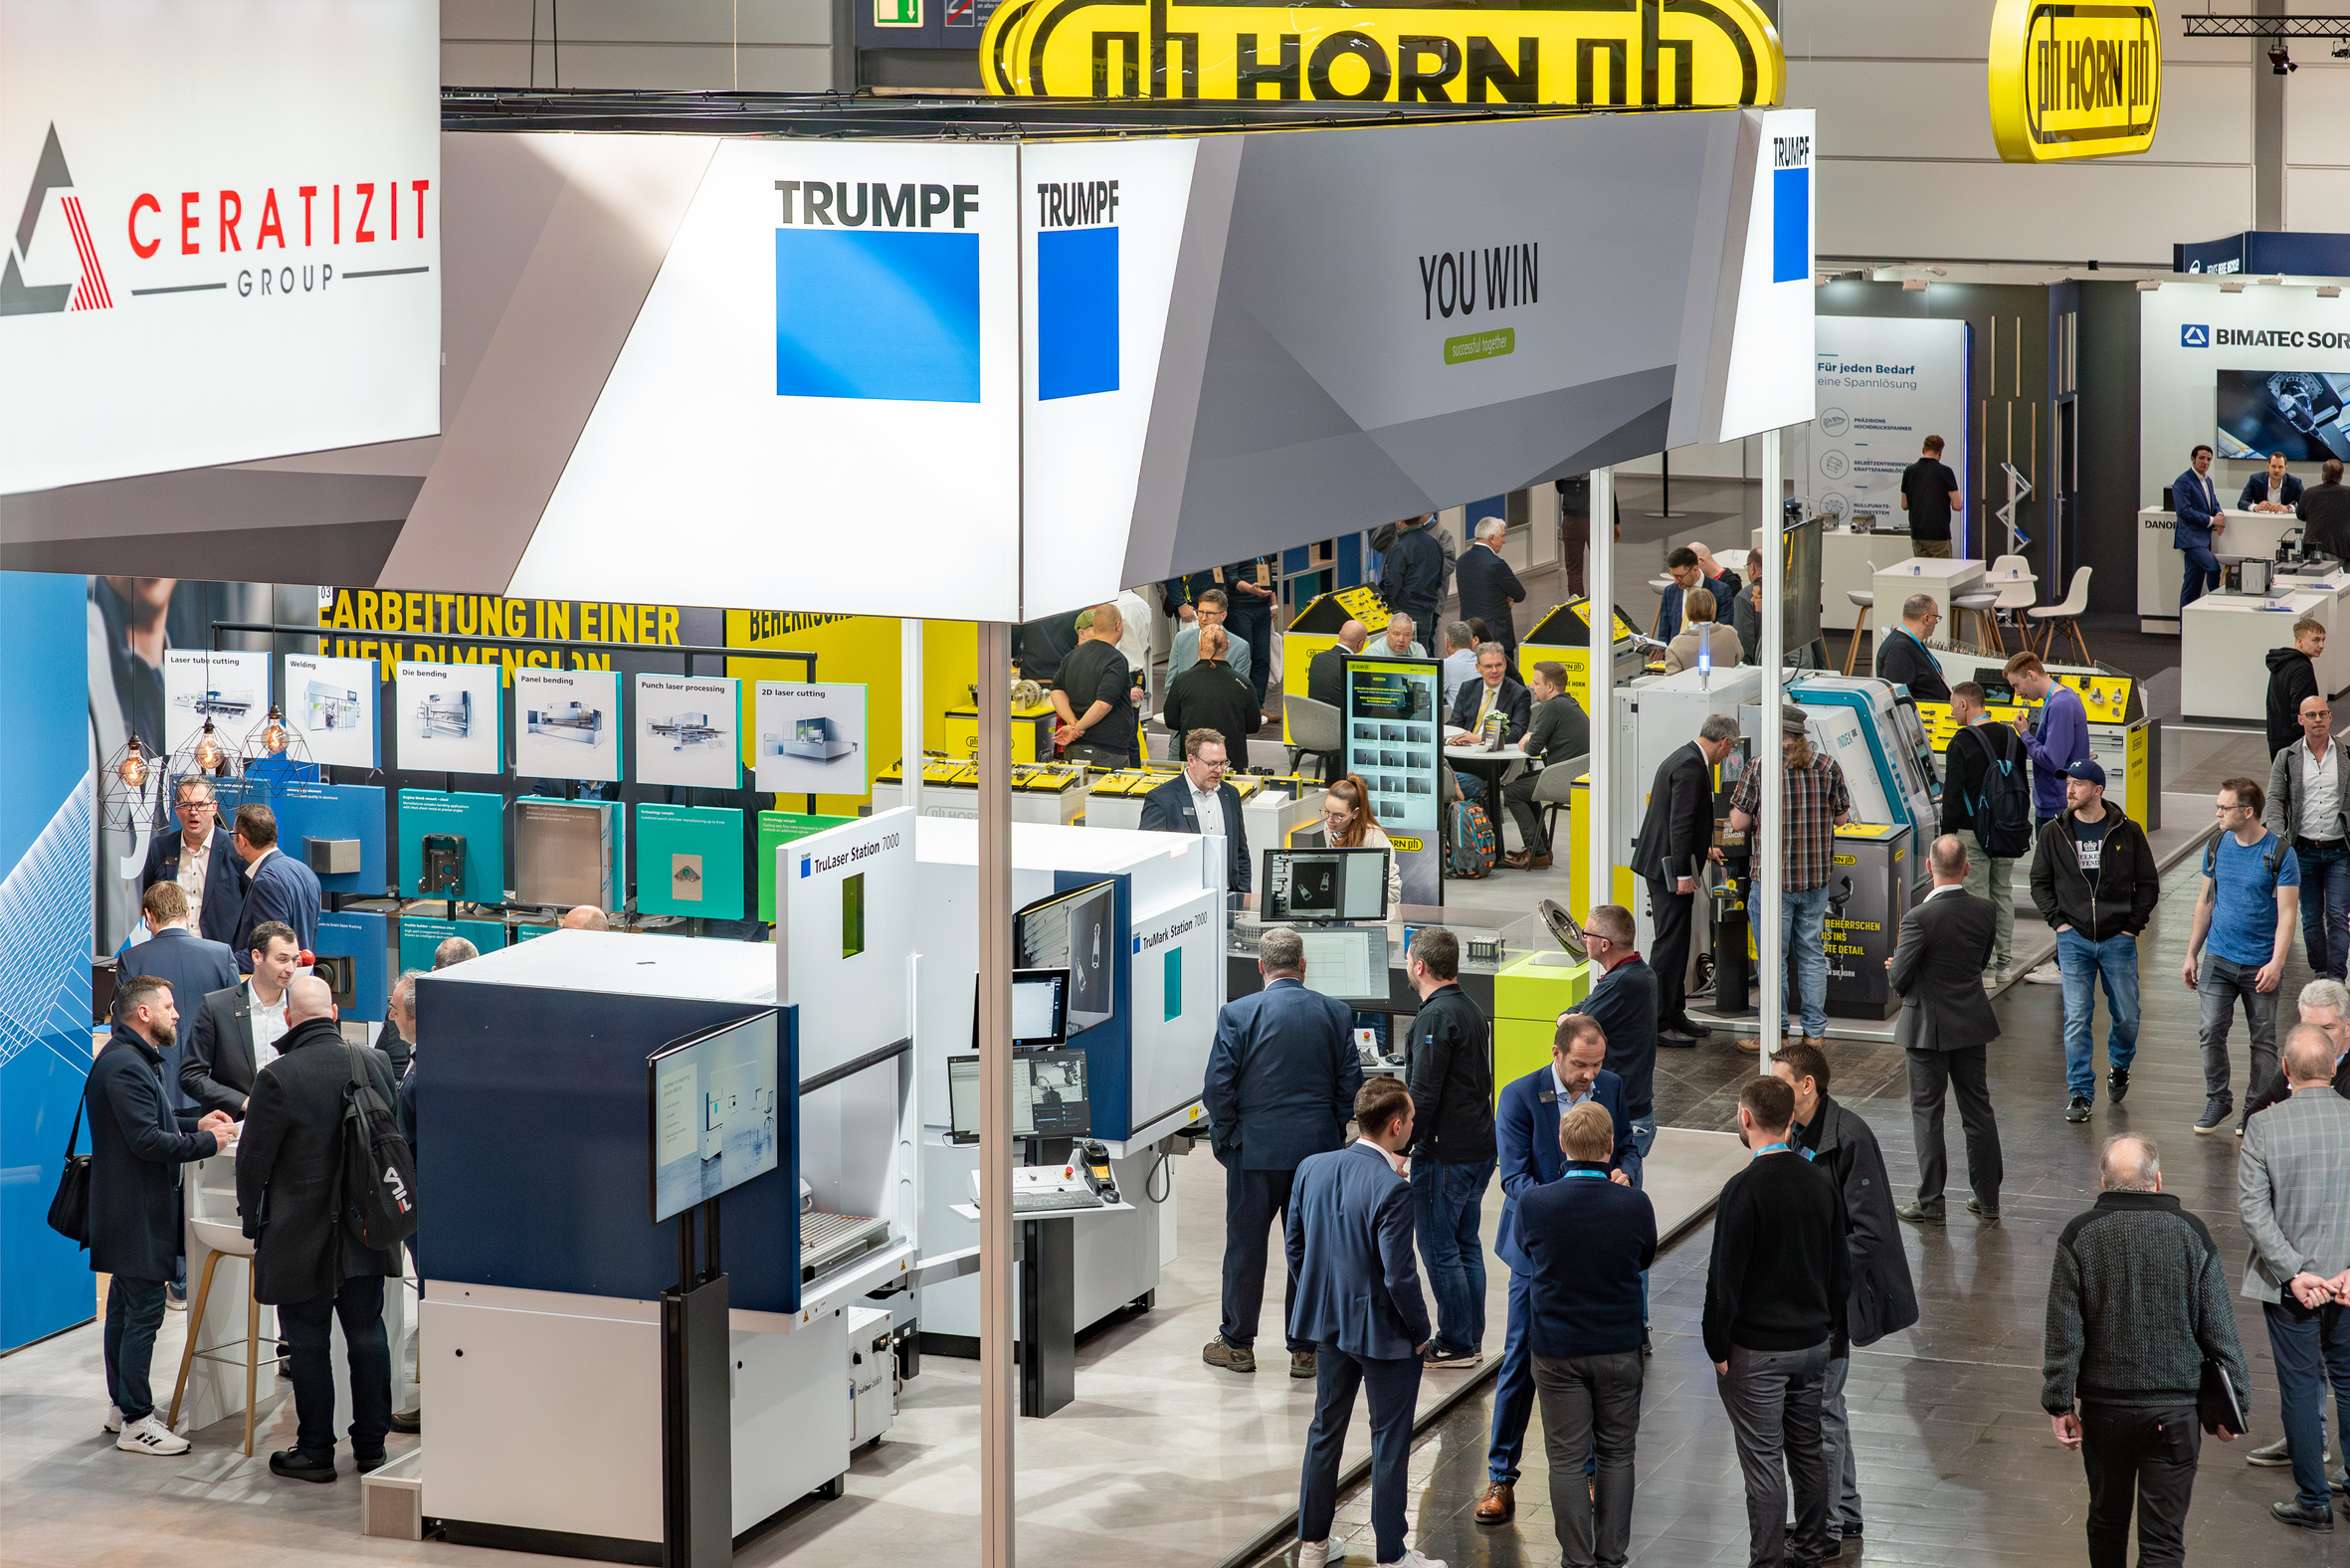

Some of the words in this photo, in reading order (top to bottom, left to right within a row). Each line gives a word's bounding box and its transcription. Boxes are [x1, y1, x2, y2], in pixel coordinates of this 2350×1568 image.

[1237, 31, 1537, 103] HORN
[2066, 37, 2123, 111] HORN
[1774, 136, 1809, 167] TRUMPF
[775, 180, 979, 228] TRUMPF
[1038, 180, 1118, 227] TRUMPF
[128, 180, 430, 259] CERATIZIT
[238, 264, 333, 297] GROUP
[1419, 251, 1475, 320] YOU
[1484, 243, 1537, 310] WIN
[1452, 337, 1480, 357] successful
[1481, 333, 1507, 355] together
[2217, 328, 2304, 347] BIMATEC
[1818, 362, 1838, 372] Für
[1840, 363, 1872, 374] jeden
[1875, 364, 1915, 375] Bedarf
[1817, 376, 1841, 386] eine
[1844, 377, 1917, 391] Spannlösung
[536, 601, 570, 640] IN
[580, 602, 681, 646] EINER
[212, 658, 240, 667] cutting
[290, 660, 316, 670] Welding
[416, 670, 448, 679] bending
[542, 677, 574, 686] bending
[685, 685, 725, 694] processing
[796, 689, 826, 698] cutting
[1836, 731, 1854, 748] INDEX
[815, 852, 849, 874] TruLaser
[851, 842, 880, 862] Station
[881, 833, 899, 851] 7000
[1143, 927, 1169, 950] TruMark
[1170, 919, 1192, 937] Station
[1194, 910, 1207, 927] 7000
[1825, 919, 1880, 931] BEHERRSCHEN
[1834, 932, 1847, 941] INS
[1839, 945, 1864, 955] DETAIL
[384, 1167, 412, 1214] FILA
